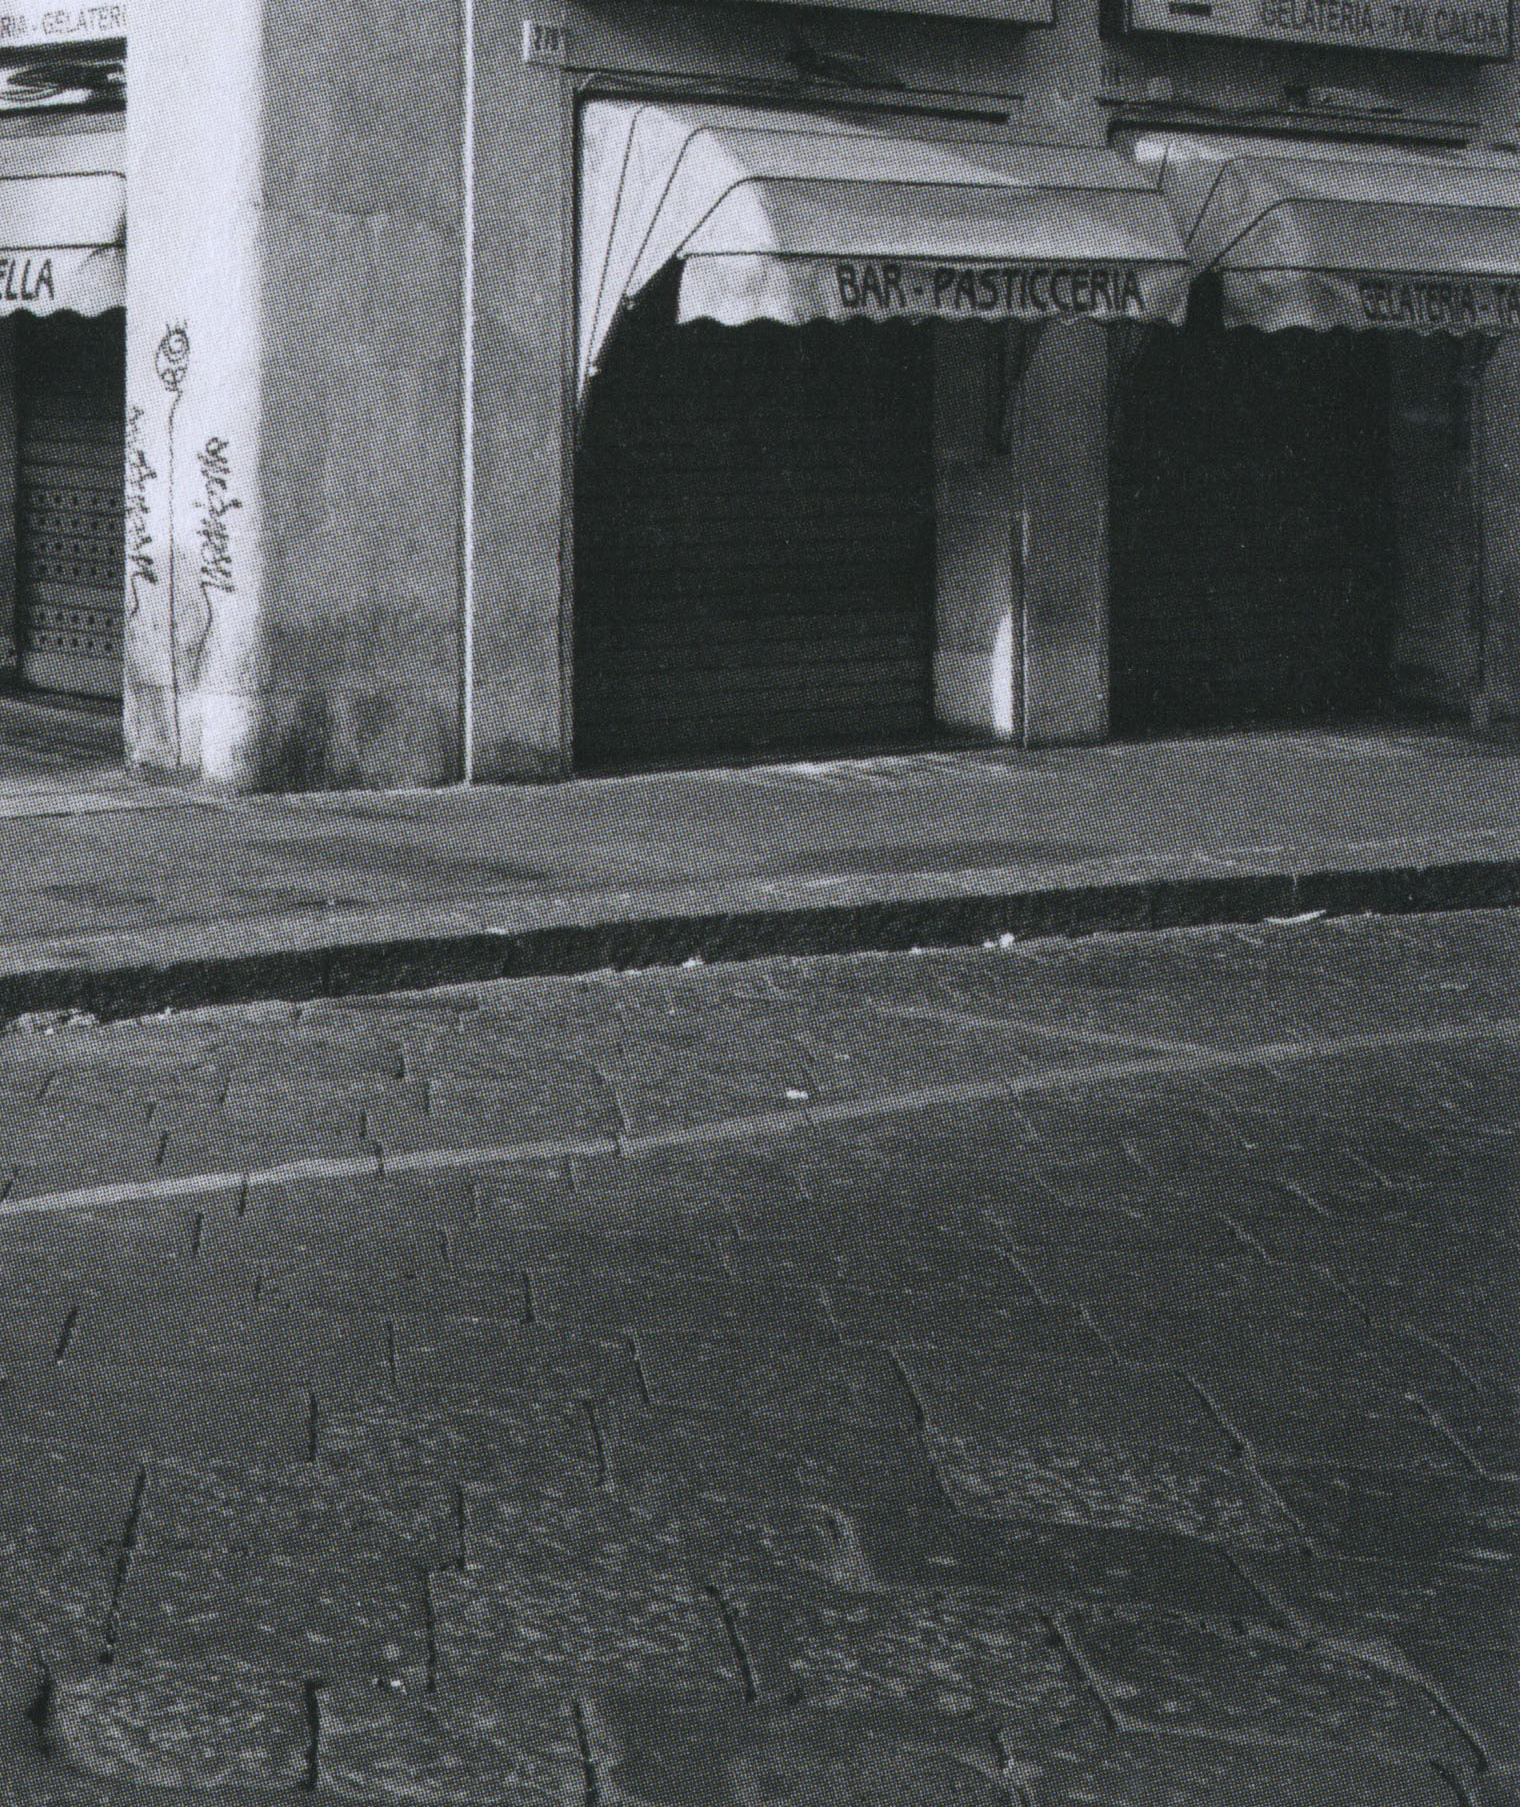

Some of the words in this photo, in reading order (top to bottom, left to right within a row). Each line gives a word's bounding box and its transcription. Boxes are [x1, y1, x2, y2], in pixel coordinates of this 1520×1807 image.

[42, 4, 127, 36] GELATERI
[836, 264, 906, 309] BAR
[933, 266, 1146, 312] PASTICCERIA
[1360, 277, 1477, 322] GELATERIA
